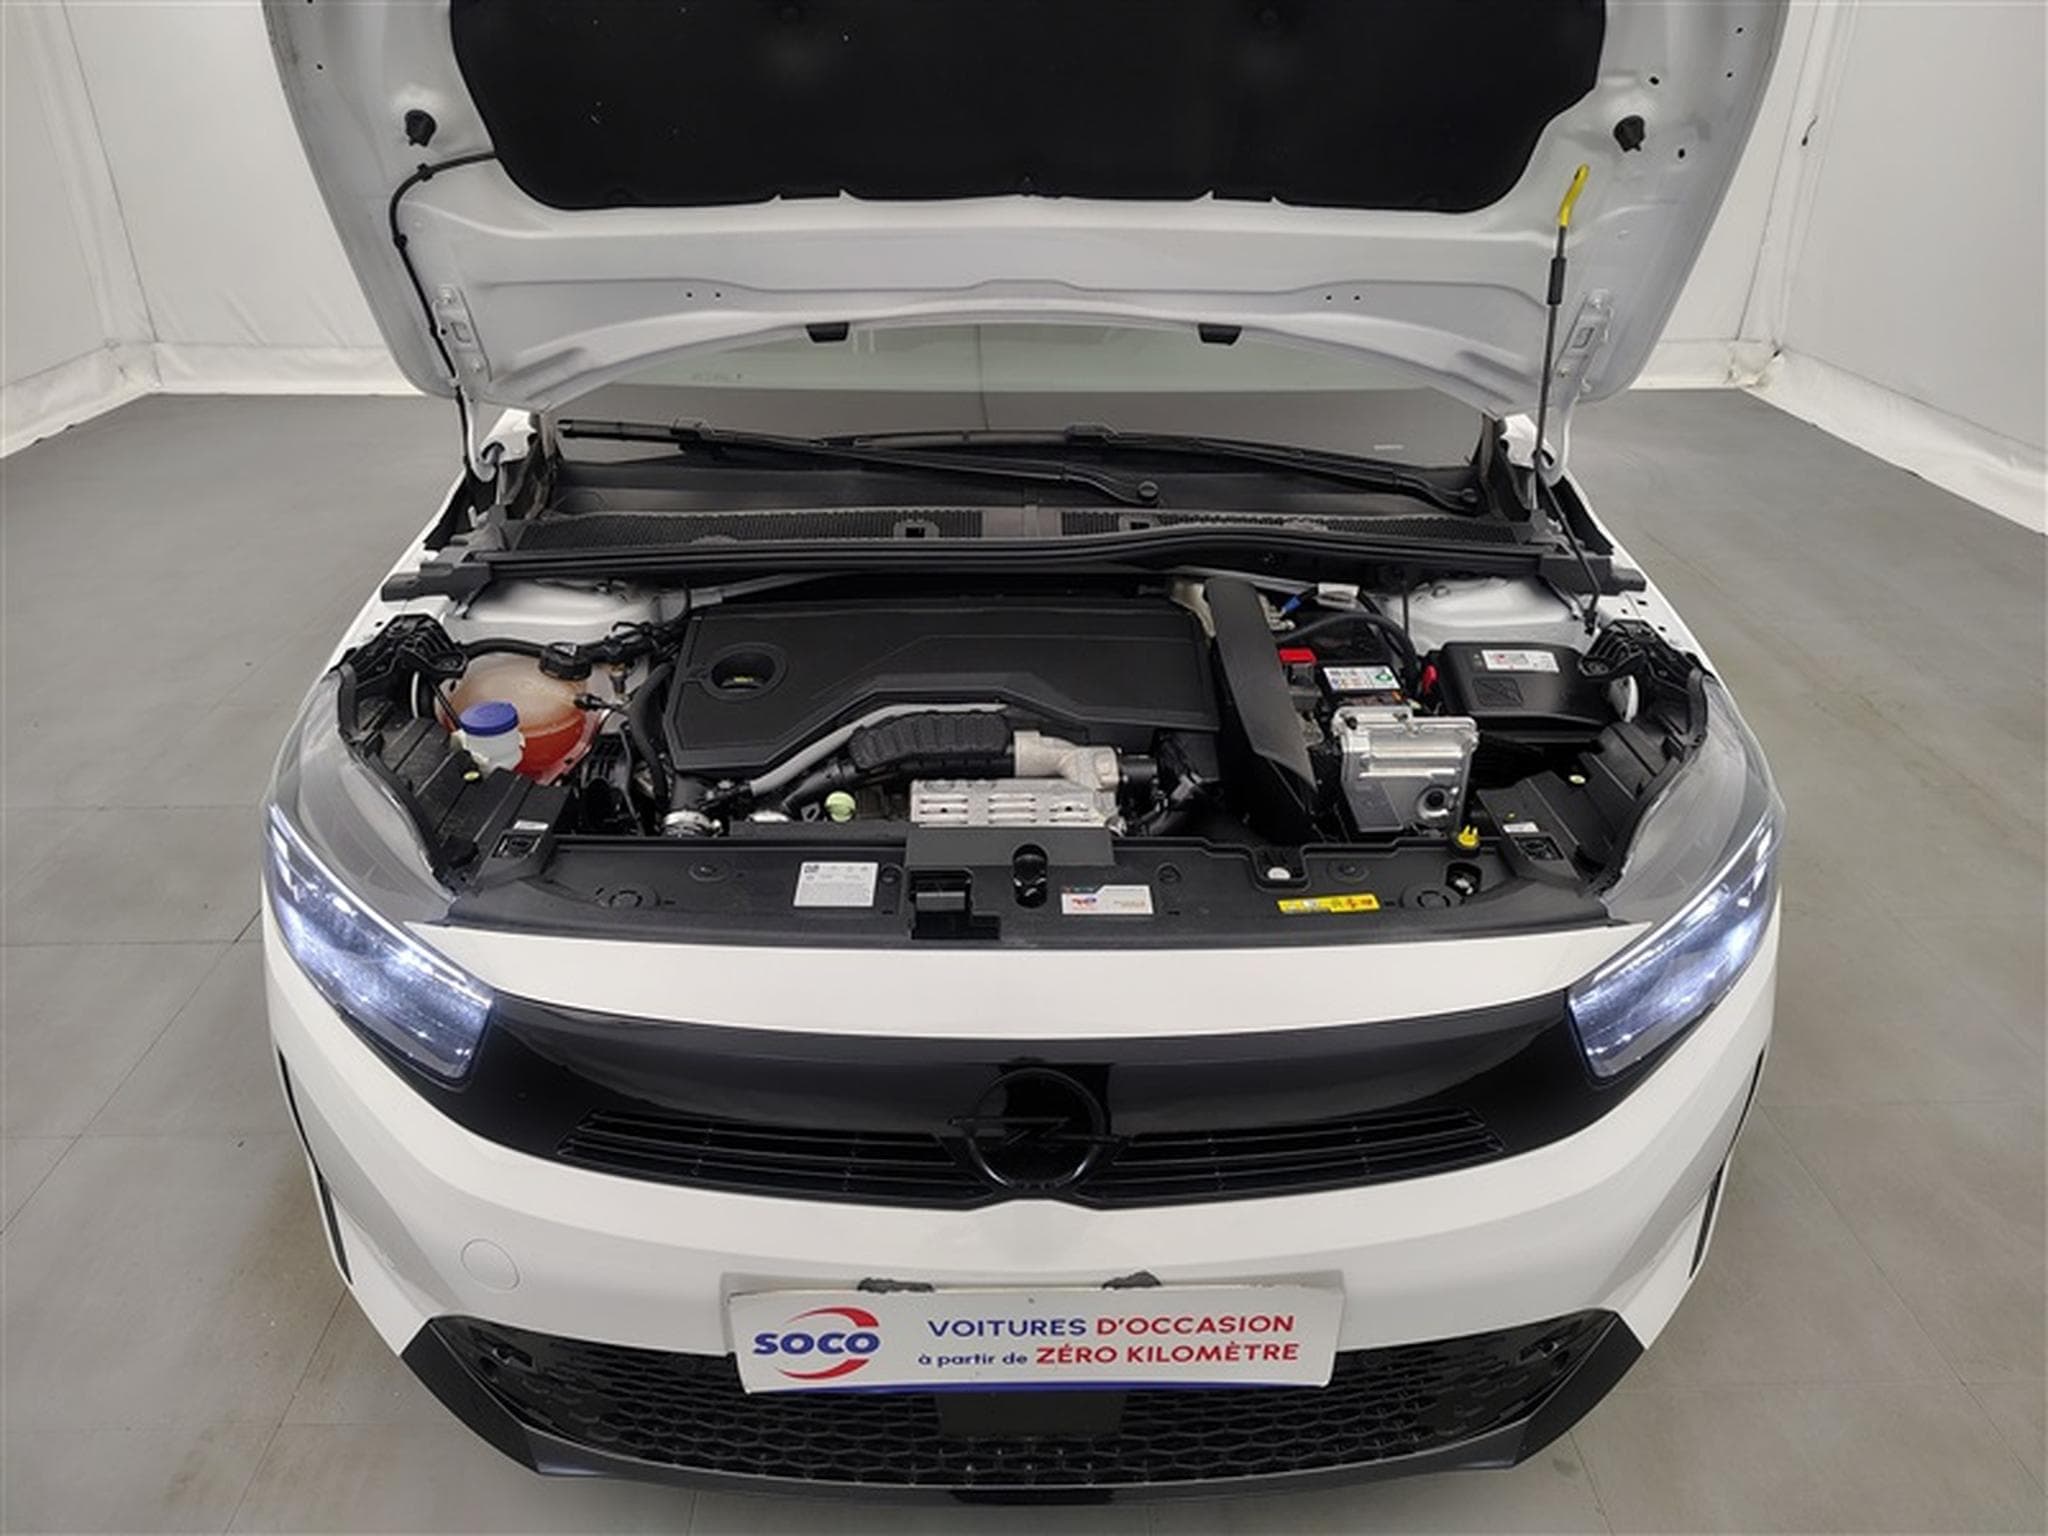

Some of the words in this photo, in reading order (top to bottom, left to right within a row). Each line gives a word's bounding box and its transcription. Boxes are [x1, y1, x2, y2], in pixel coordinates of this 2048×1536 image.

[927, 1319, 1087, 1338] VOITURES
[1096, 1314, 1295, 1336] D'OCCASION
[753, 1331, 881, 1355] SOCO
[918, 1352, 932, 1365] à
[937, 1352, 995, 1369] partir
[1002, 1352, 1028, 1365] de
[1036, 1342, 1118, 1365] ZÉRO
[1126, 1340, 1300, 1364] KILOMÈTRE
